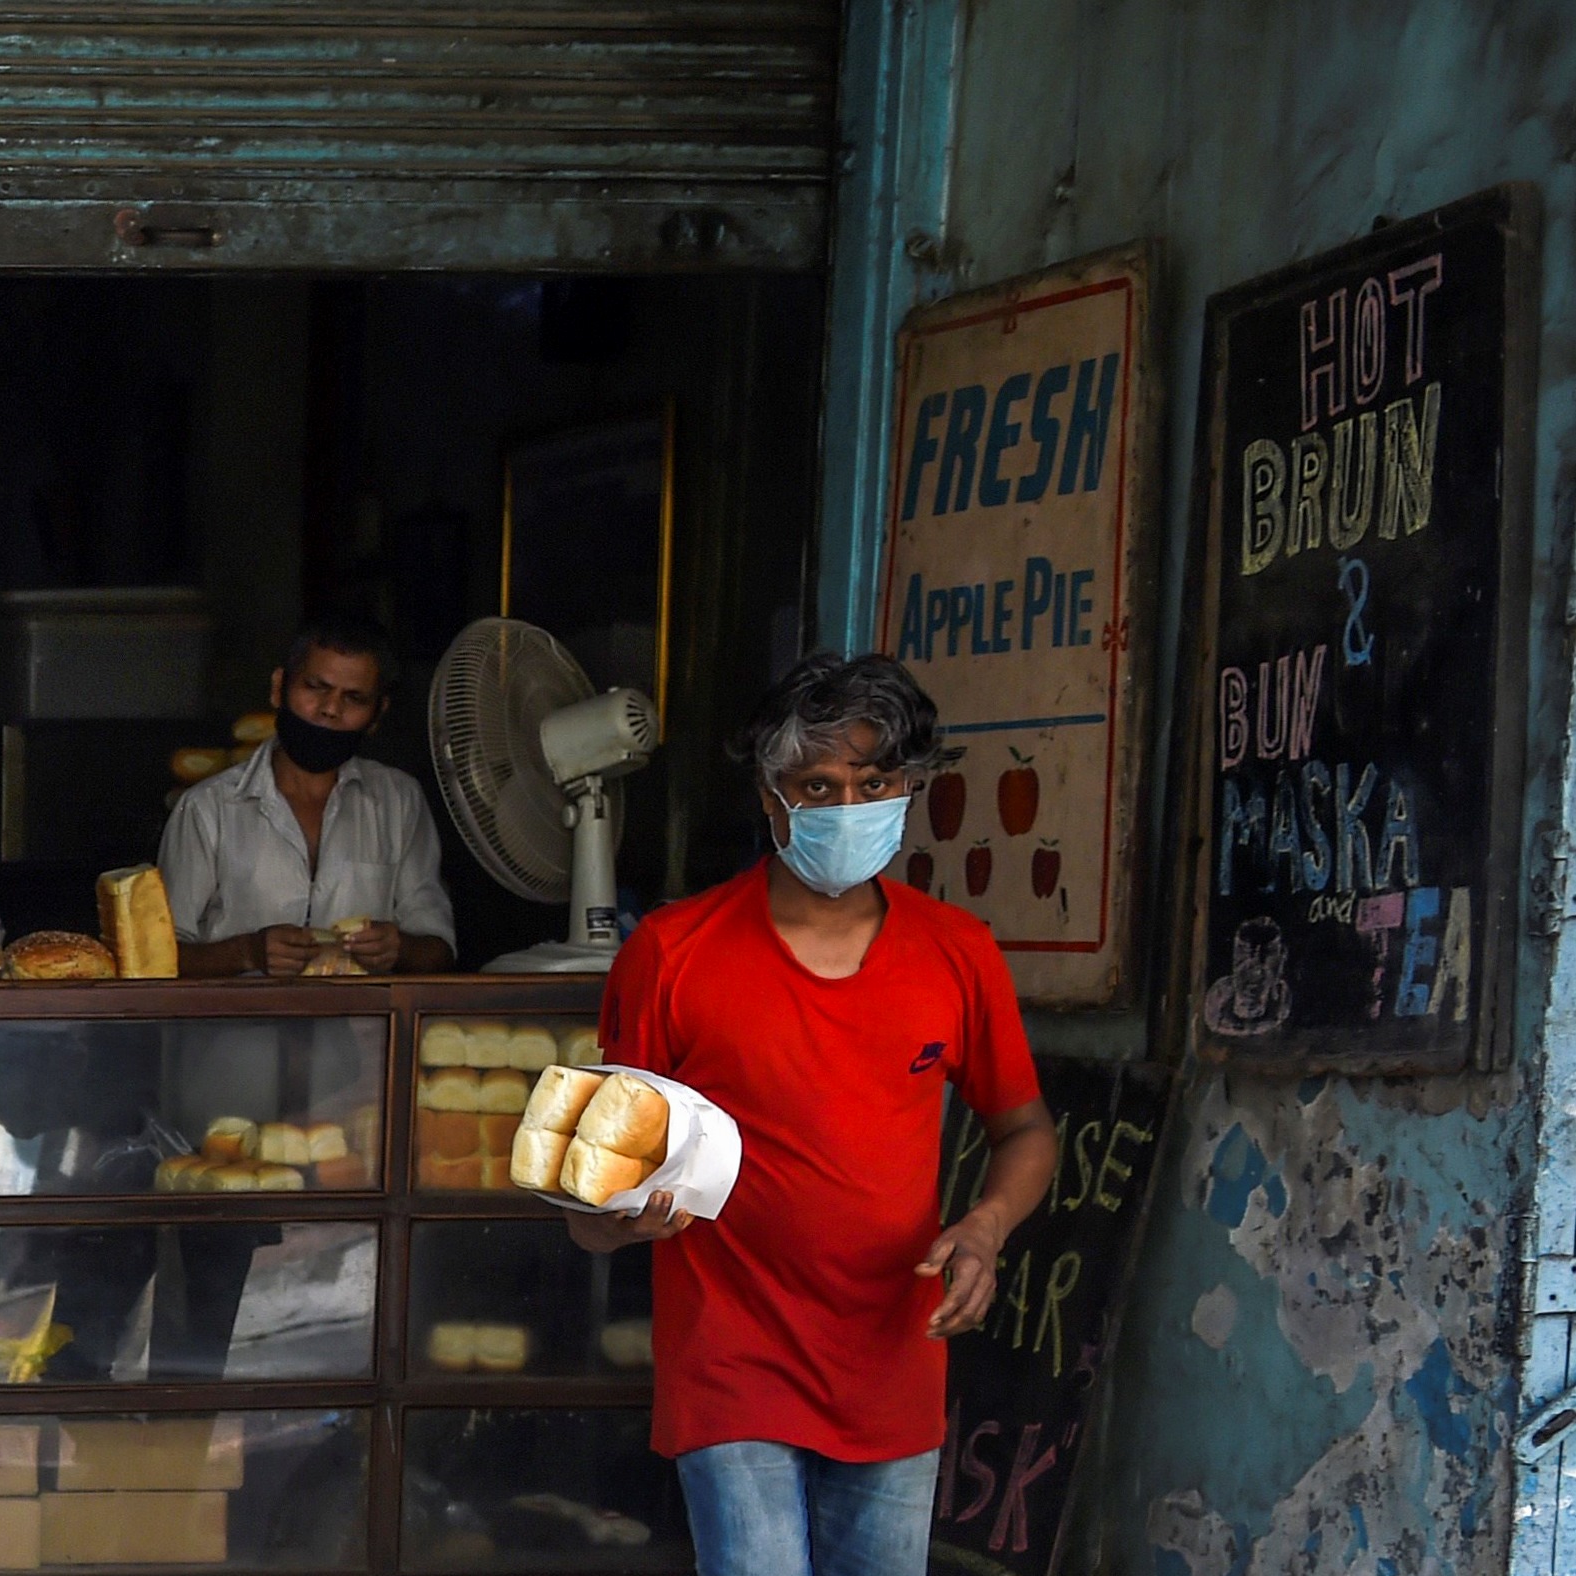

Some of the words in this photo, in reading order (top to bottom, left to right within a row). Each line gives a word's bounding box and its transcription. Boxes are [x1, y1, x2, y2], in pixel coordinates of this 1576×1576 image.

[1298, 252, 1445, 433] HOT
[901, 352, 1120, 523] FRESH
[1239, 382, 1443, 578] BRUN
[897, 572, 1017, 663] APPLE
[1022, 555, 1095, 653] PIE
[1219, 645, 1328, 771] BUN
[1218, 760, 1421, 897] MASKA
[1307, 891, 1356, 925] and
[1356, 885, 1473, 1022] TEA
